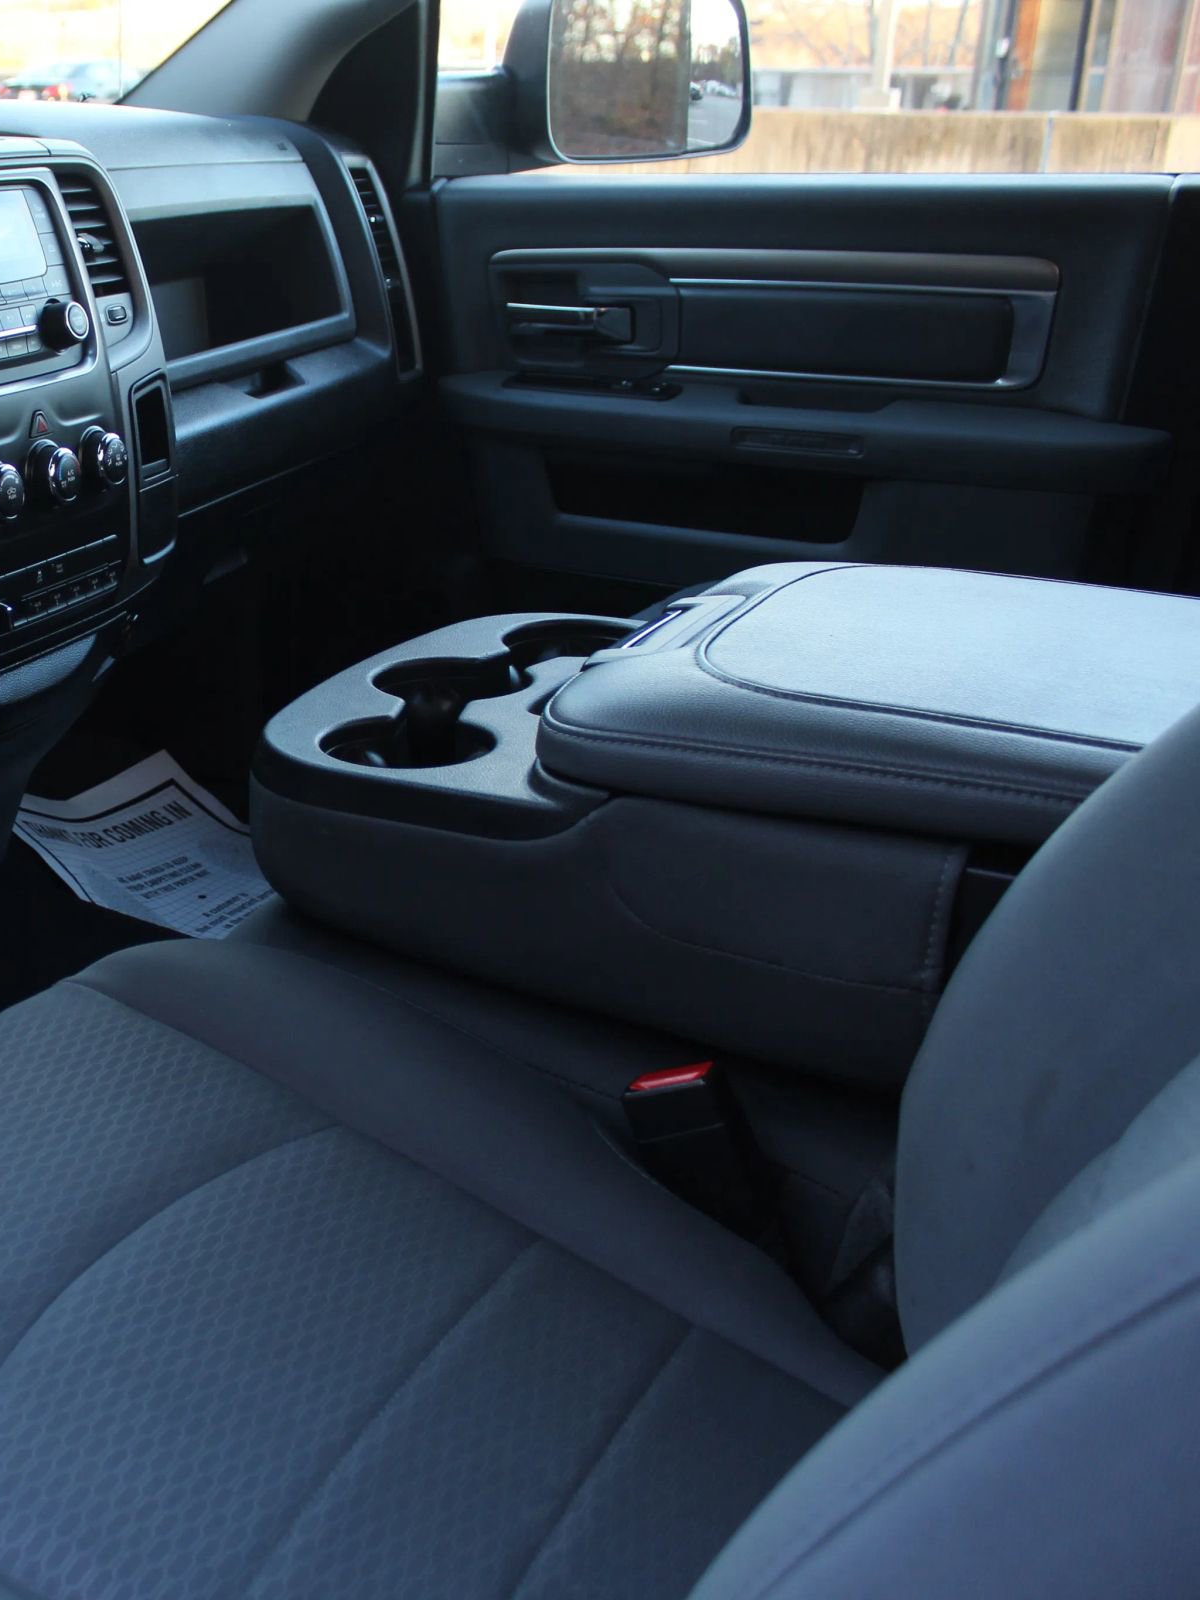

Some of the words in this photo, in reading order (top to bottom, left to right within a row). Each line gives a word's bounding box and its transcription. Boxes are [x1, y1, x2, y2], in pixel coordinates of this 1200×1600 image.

[72, 828, 114, 849] FOR
[103, 809, 174, 843] COMING
[163, 800, 193, 821] IN
